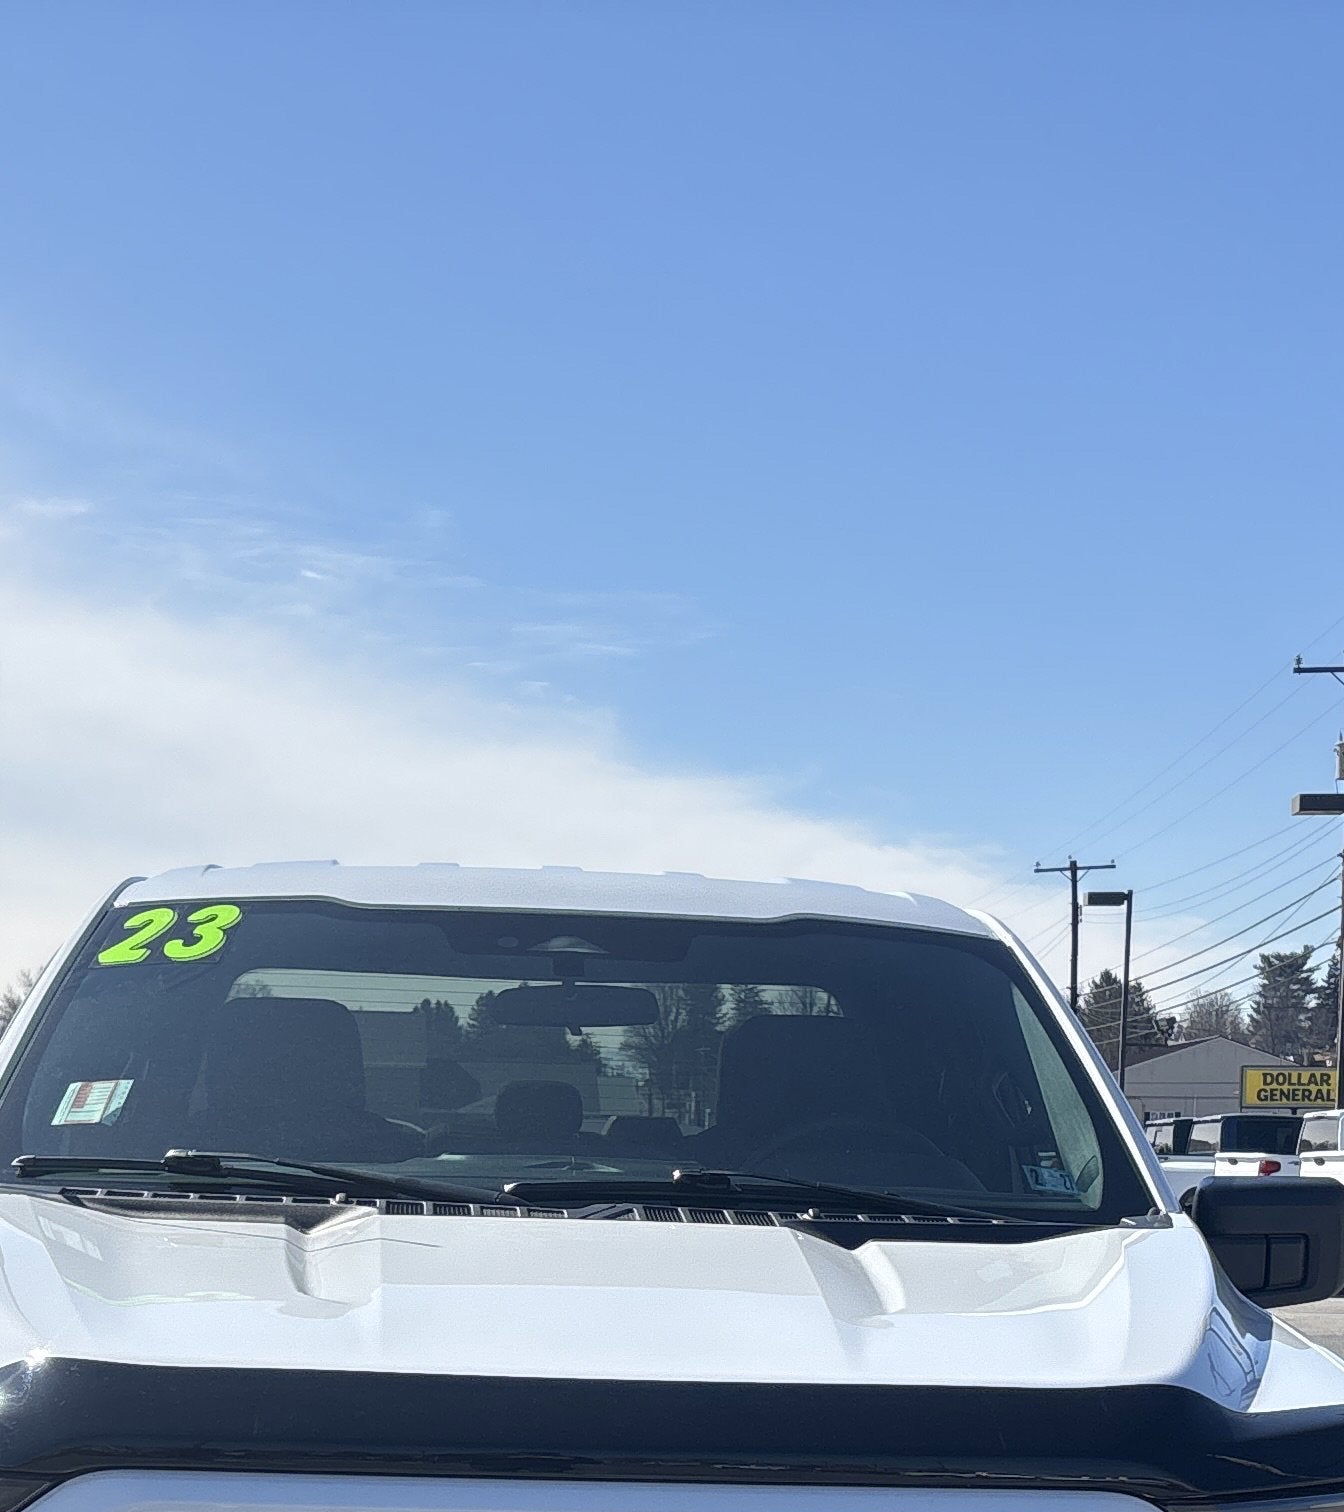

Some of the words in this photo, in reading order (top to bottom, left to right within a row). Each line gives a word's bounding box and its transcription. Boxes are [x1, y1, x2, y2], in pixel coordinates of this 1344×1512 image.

[97, 903, 244, 966] 23
[1262, 1072, 1332, 1087] DOLLAR
[1256, 1088, 1336, 1103] GENERAL
